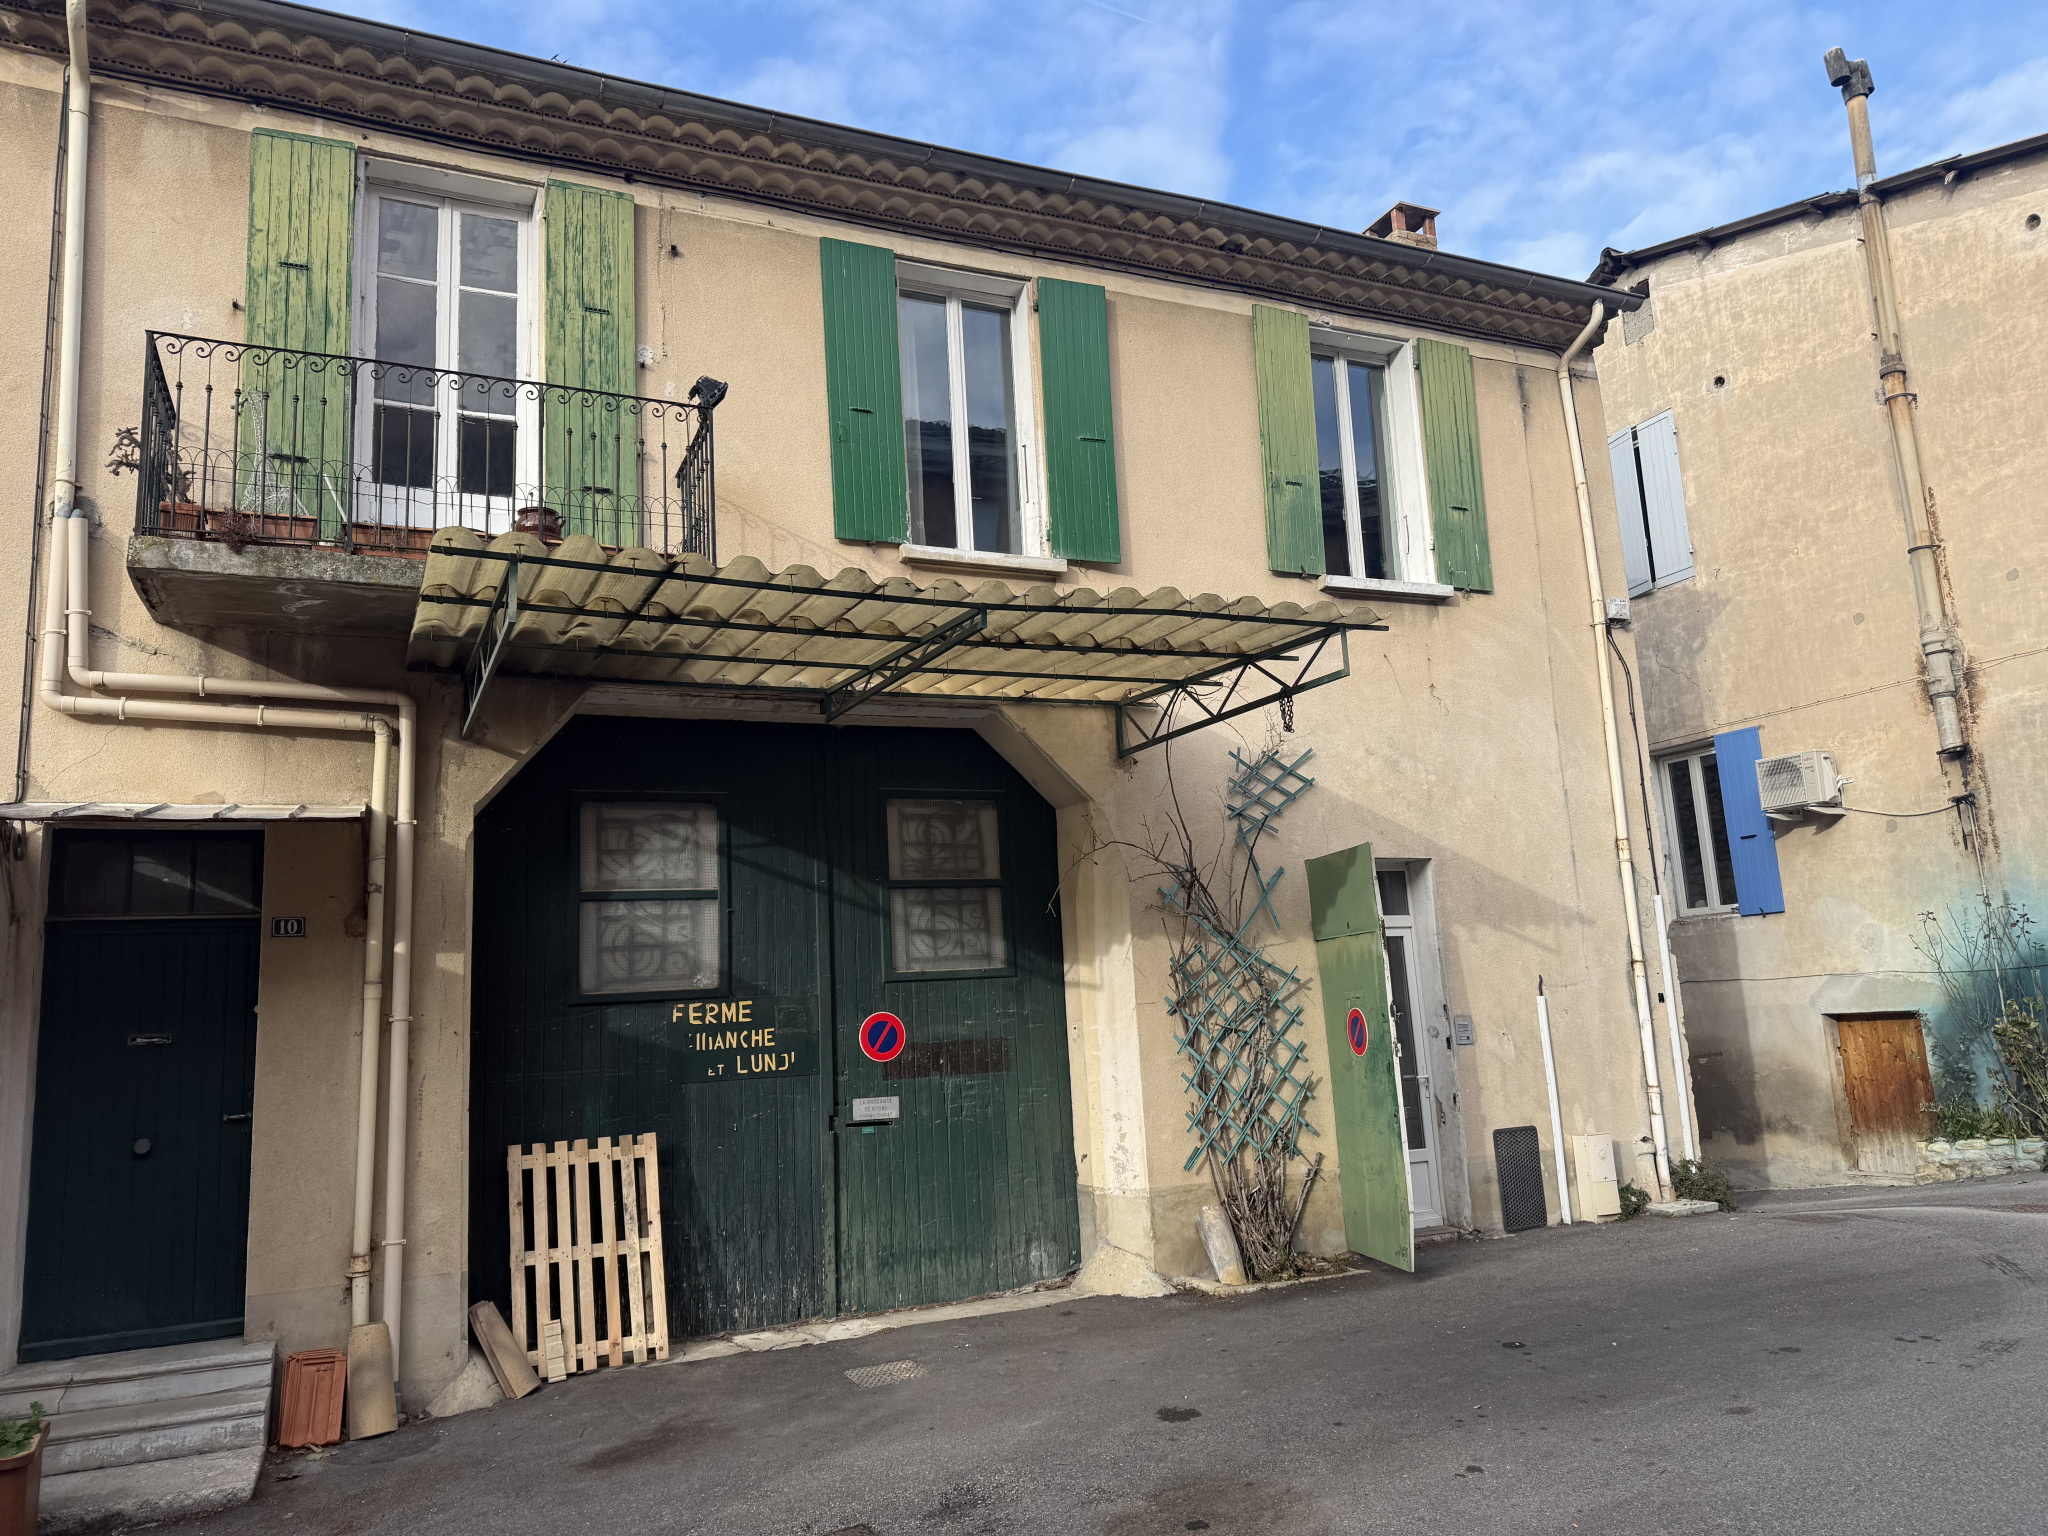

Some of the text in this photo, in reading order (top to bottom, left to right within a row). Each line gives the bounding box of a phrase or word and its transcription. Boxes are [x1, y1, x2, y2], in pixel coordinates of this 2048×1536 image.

[279, 919, 298, 934] 10
[672, 1000, 753, 1025] FERME
[688, 1028, 776, 1051] IANCHE
